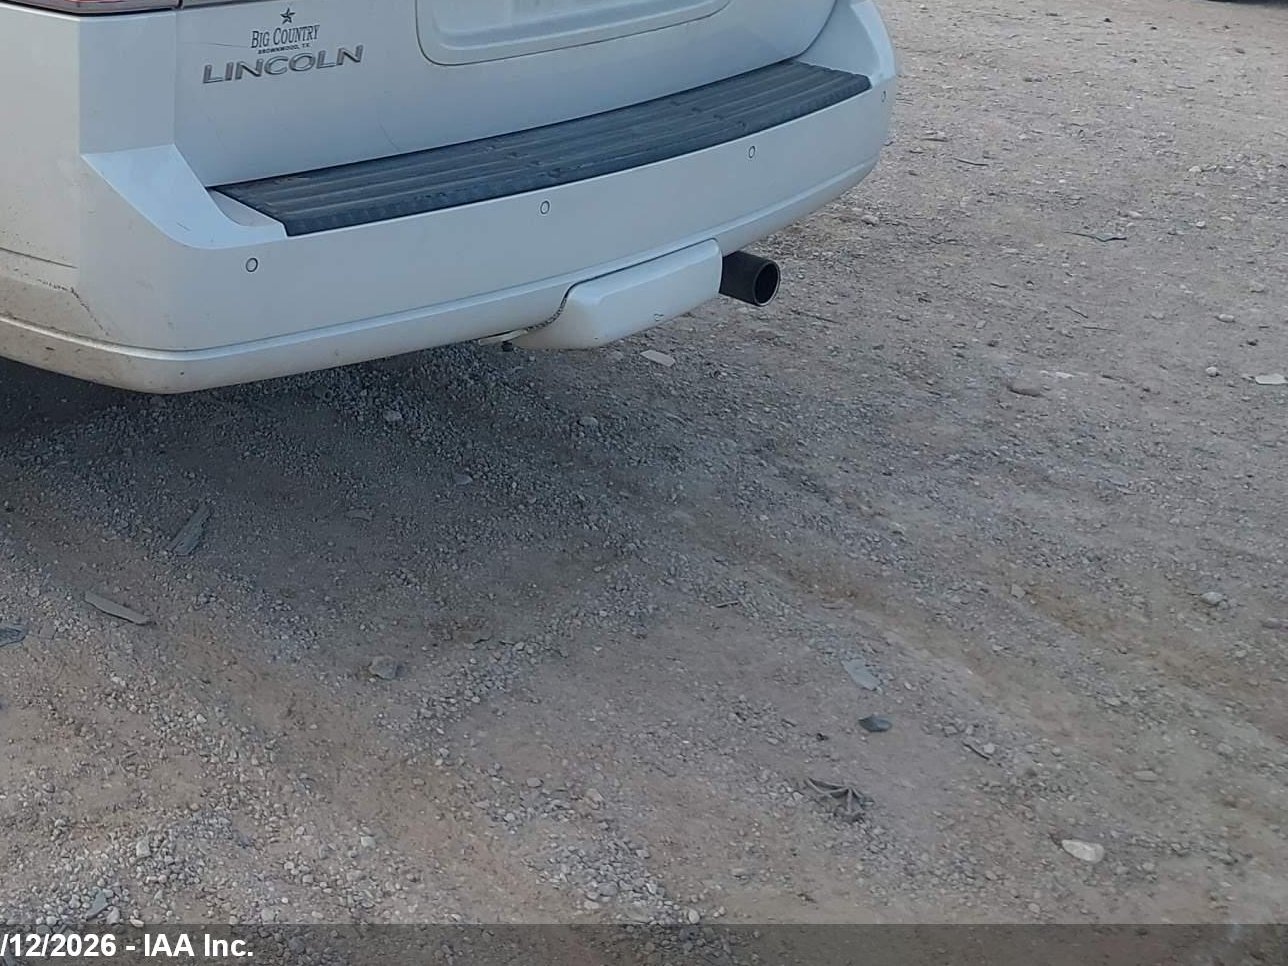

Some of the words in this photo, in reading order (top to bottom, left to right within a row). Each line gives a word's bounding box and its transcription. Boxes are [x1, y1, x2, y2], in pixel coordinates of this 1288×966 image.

[251, 30, 270, 49] BIG
[273, 24, 321, 45] COUNTRY
[202, 44, 364, 84] LINCOLN
